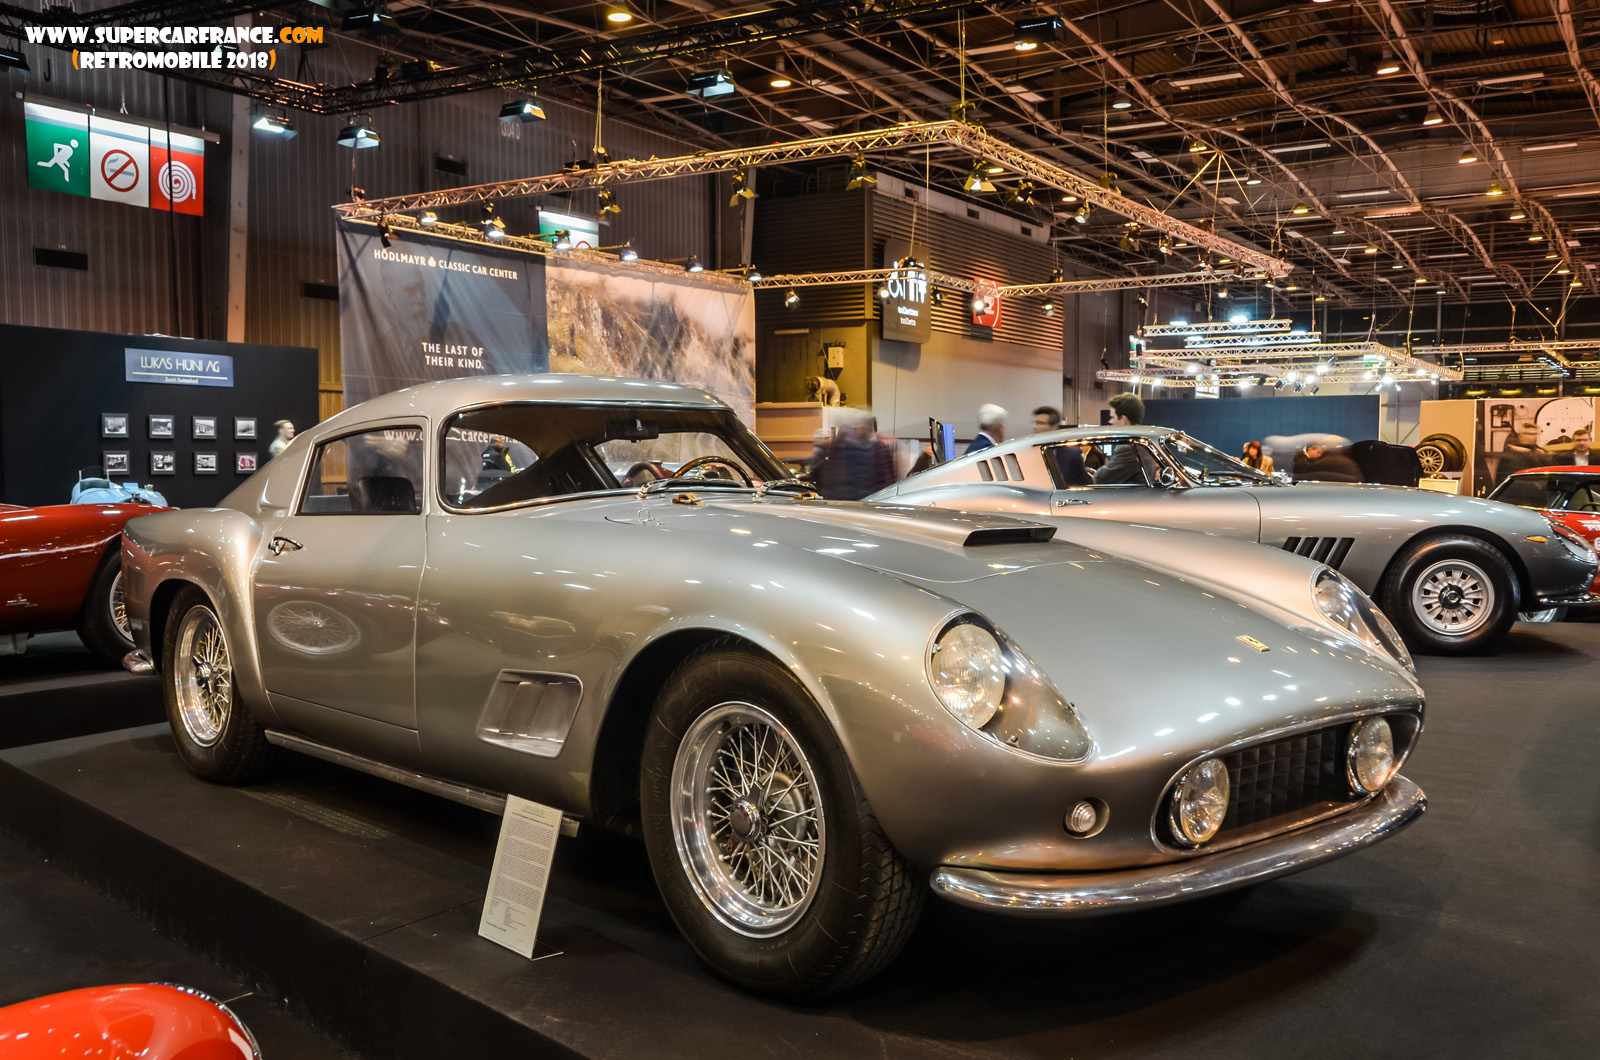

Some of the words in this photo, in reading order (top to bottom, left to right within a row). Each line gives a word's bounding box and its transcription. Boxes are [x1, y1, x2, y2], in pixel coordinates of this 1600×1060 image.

[374, 249, 426, 266] HÖDLMAYR
[438, 259, 471, 272] CLASSIC
[472, 265, 488, 276] CAR
[489, 267, 518, 280] CENTER
[422, 342, 441, 354] THE
[445, 344, 468, 356] LAST
[471, 347, 484, 357] OF
[140, 356, 173, 370] LUKAS
[205, 361, 220, 373] AG
[425, 355, 454, 368] THEIR
[457, 358, 484, 370] KIND.
